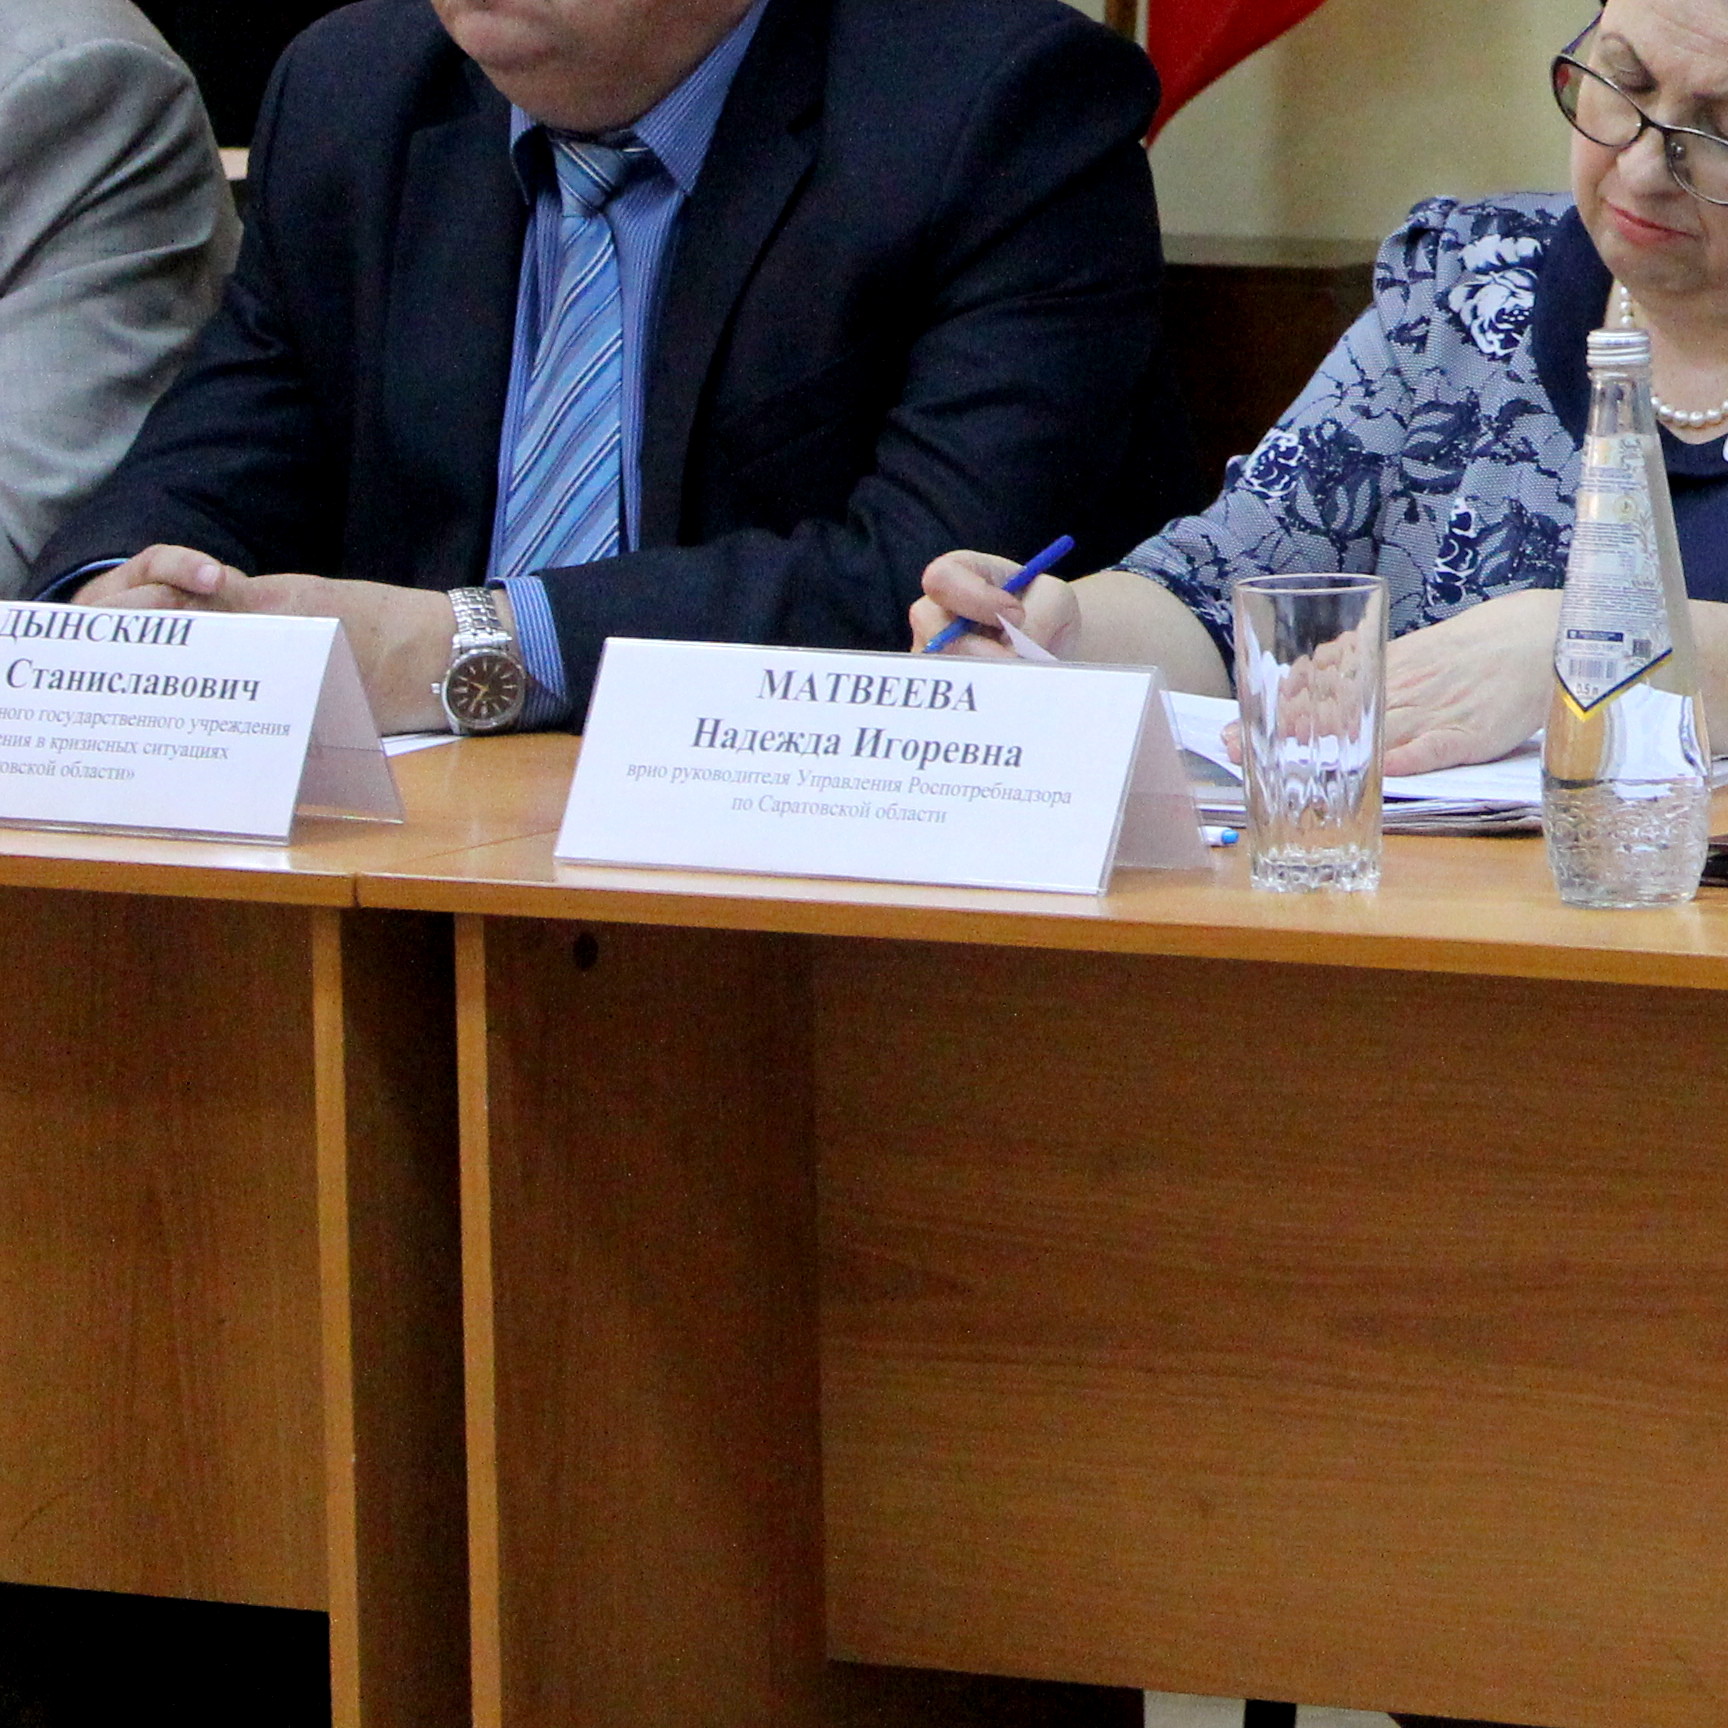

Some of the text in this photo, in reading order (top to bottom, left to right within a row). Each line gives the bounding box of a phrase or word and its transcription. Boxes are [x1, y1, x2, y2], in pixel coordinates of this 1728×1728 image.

[6, 658, 261, 701] Станиславович
[756, 668, 977, 712] МАТВЕЕВА
[38, 709, 185, 729] государственного
[187, 718, 291, 736] учреждения
[0, 734, 229, 760] ния в кризисных ситуациях
[690, 717, 1023, 771] Надежда Игоревна
[60, 760, 136, 781] области»
[627, 764, 1071, 808] врио руководителя Управления Роспотребнадзора
[732, 795, 947, 823] по Саратовской области
